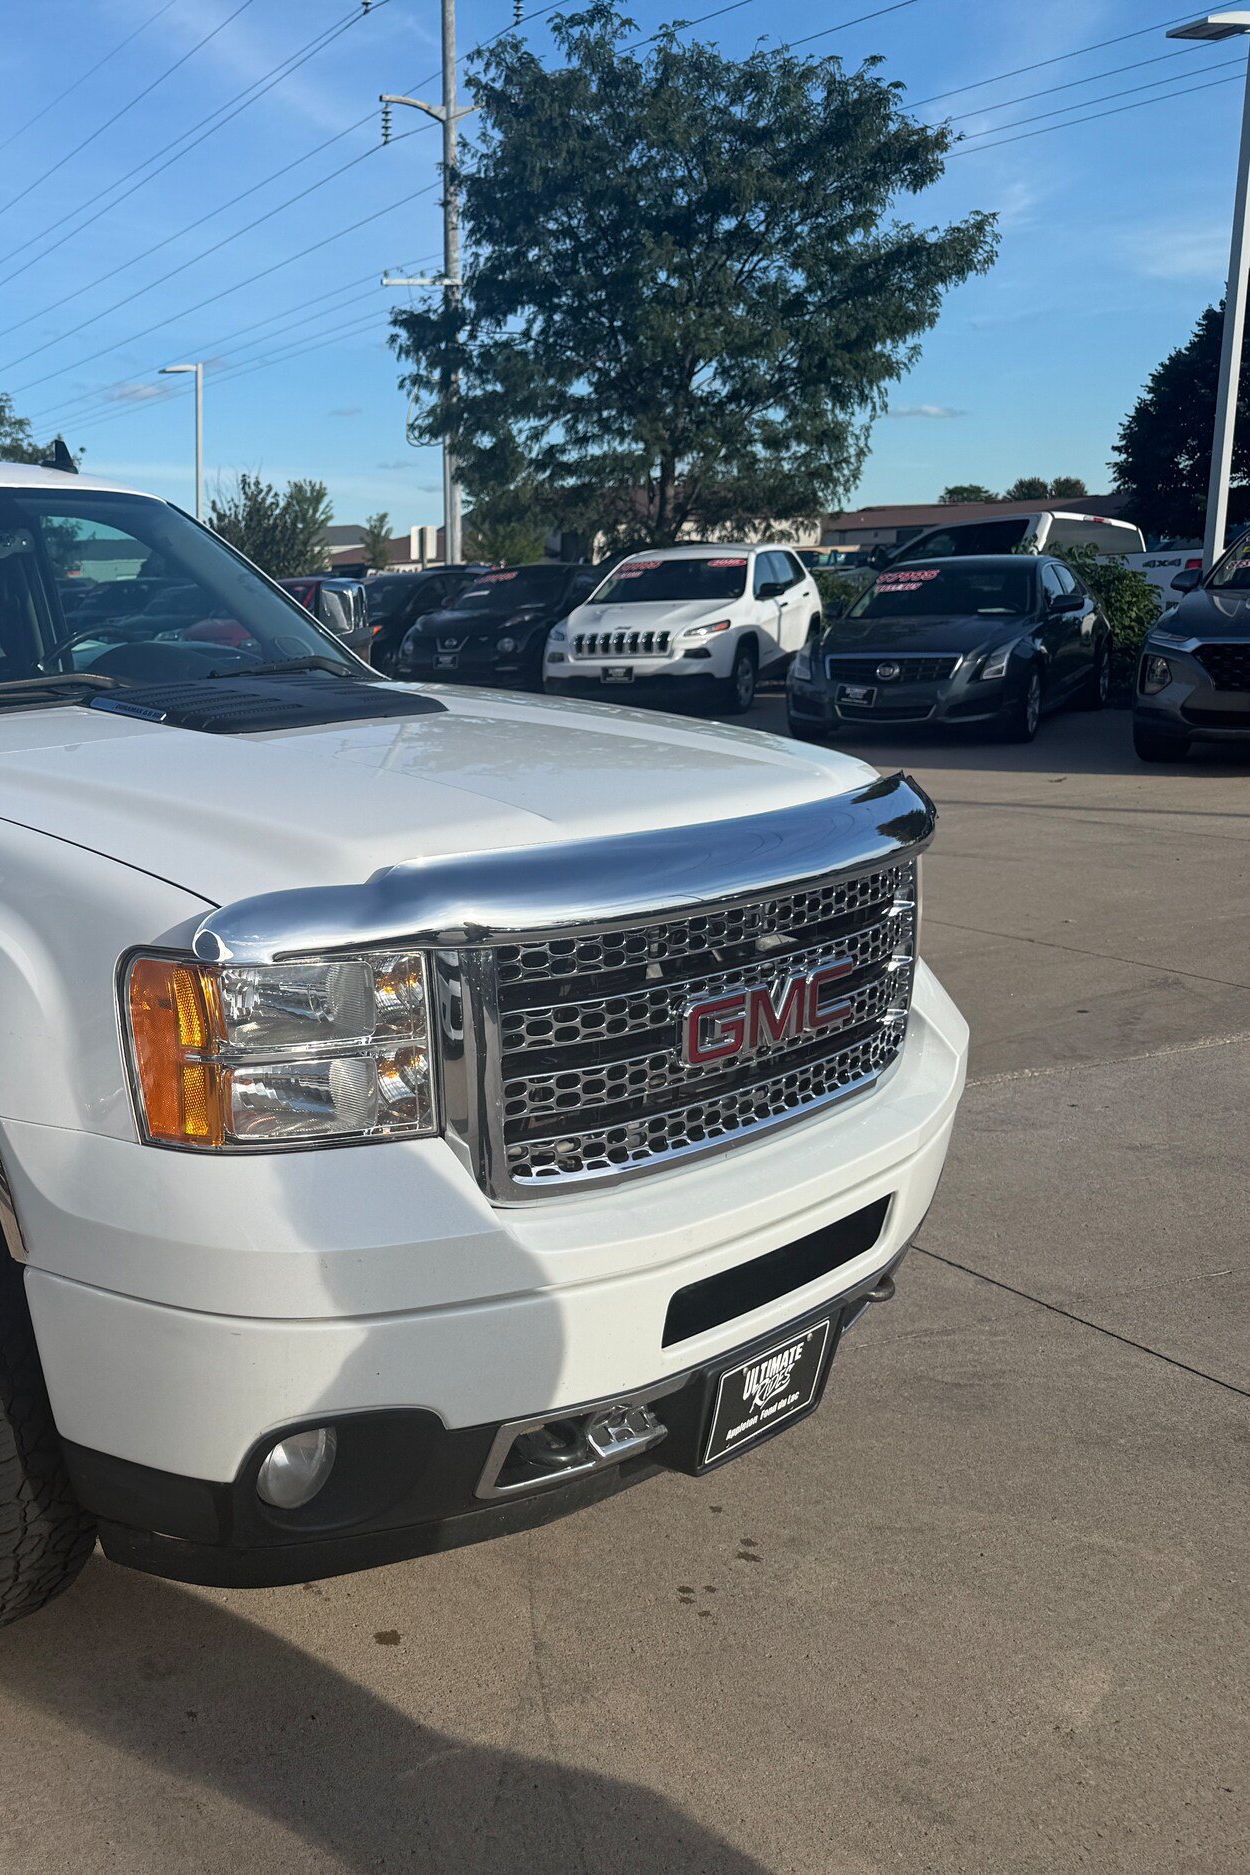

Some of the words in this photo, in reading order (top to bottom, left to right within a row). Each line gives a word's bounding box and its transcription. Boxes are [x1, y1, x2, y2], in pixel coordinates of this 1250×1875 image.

[679, 956, 853, 1067] GMC
[742, 1341, 805, 1401] ULTIMATE
[749, 1363, 795, 1414] RIDES
[725, 1416, 758, 1441] Appleton
[760, 1405, 777, 1421] Fond
[777, 1400, 787, 1411] du
[787, 1391, 800, 1406] Lac
